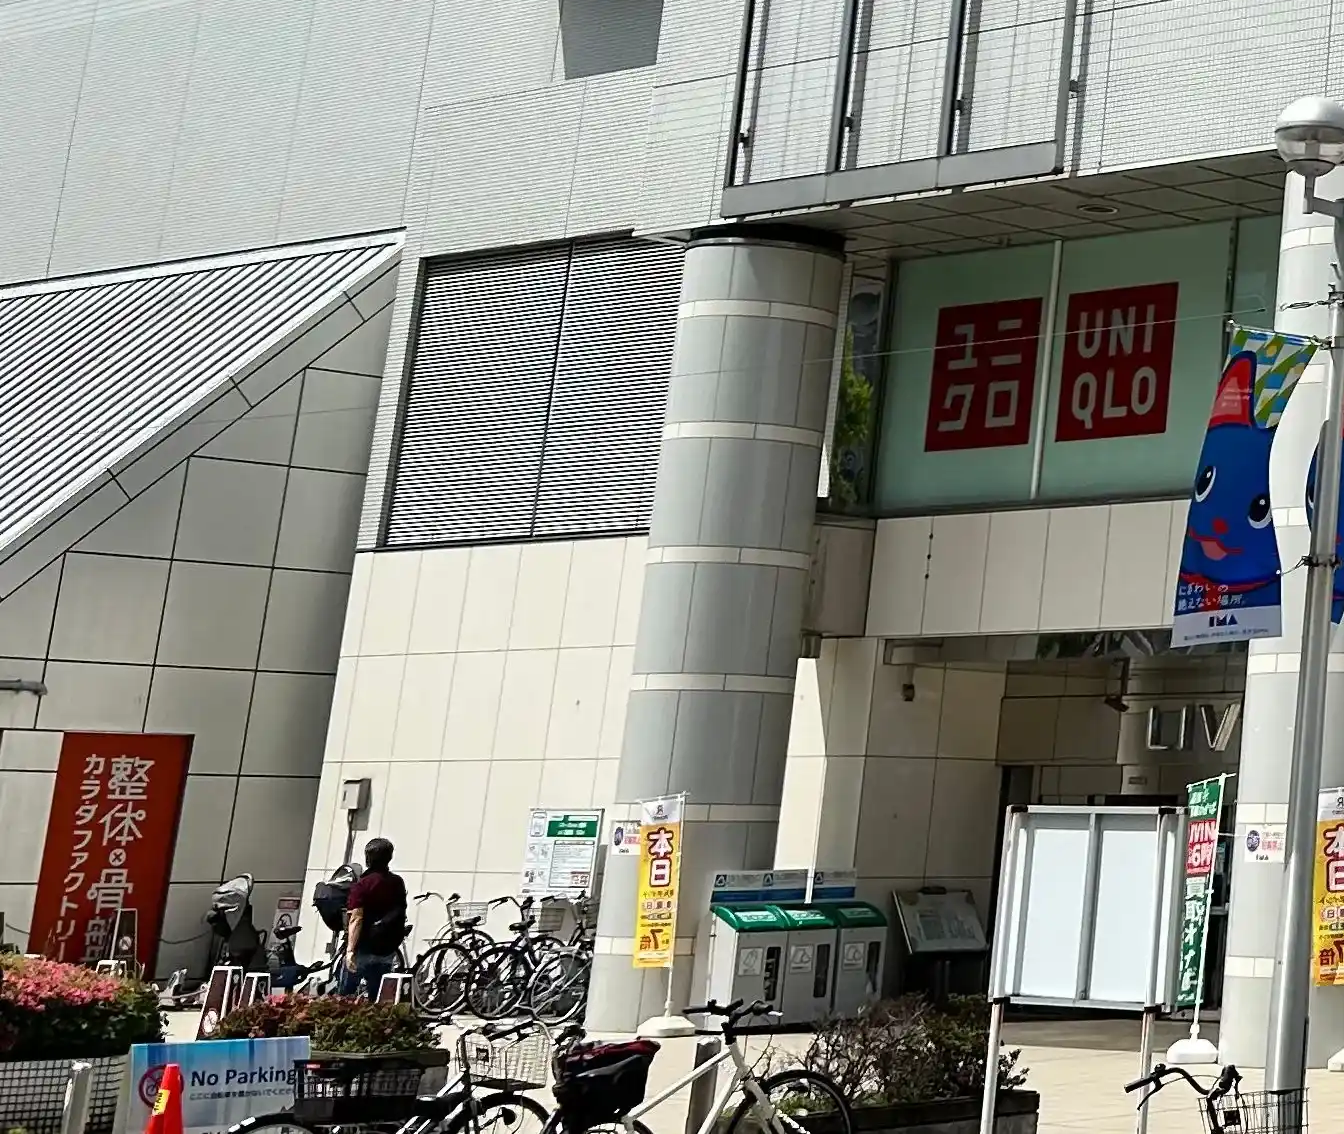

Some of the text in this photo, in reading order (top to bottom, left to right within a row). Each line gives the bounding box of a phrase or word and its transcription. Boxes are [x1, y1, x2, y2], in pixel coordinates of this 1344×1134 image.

[948, 318, 1023, 369] ユニ
[1077, 304, 1155, 359] UNI
[938, 380, 1019, 432] クロ
[1072, 367, 1155, 430] QLO
[1208, 614, 1238, 627] IMA
[1146, 704, 1241, 751] LIV
[647, 826, 674, 887] 本日
[191, 1066, 297, 1087] No Parking
